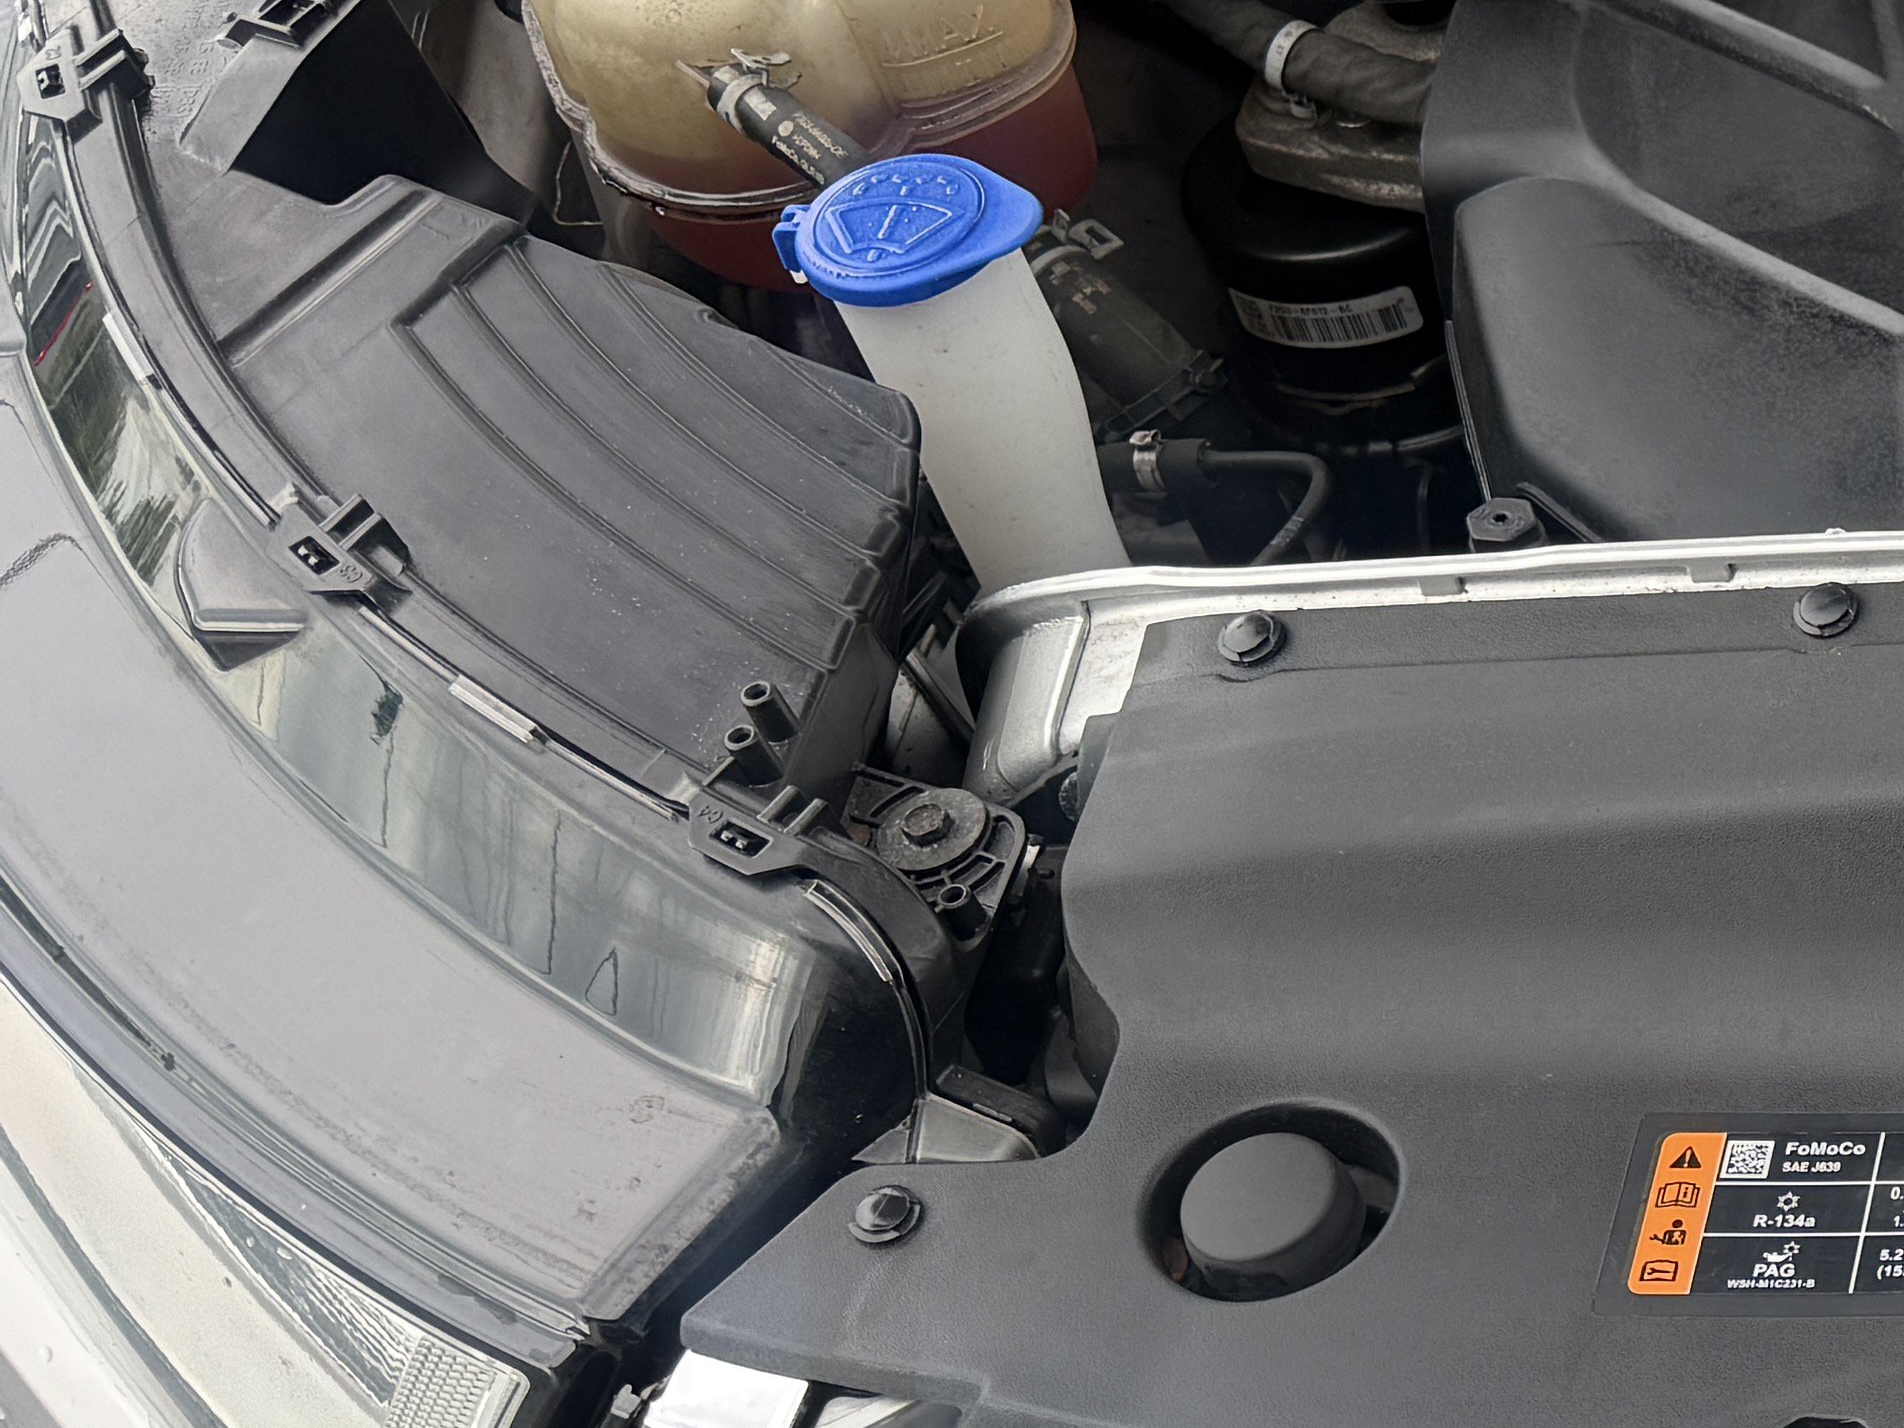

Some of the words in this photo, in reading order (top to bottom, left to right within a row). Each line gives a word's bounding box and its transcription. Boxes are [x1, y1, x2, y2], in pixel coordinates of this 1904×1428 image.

[1785, 1141, 1866, 1156] FoMoCo
[1782, 1162, 1809, 1172] SAE
[1753, 1214, 1816, 1228] R-134a
[1879, 1249, 1904, 1261] 5.2
[1752, 1263, 1796, 1277] PAG
